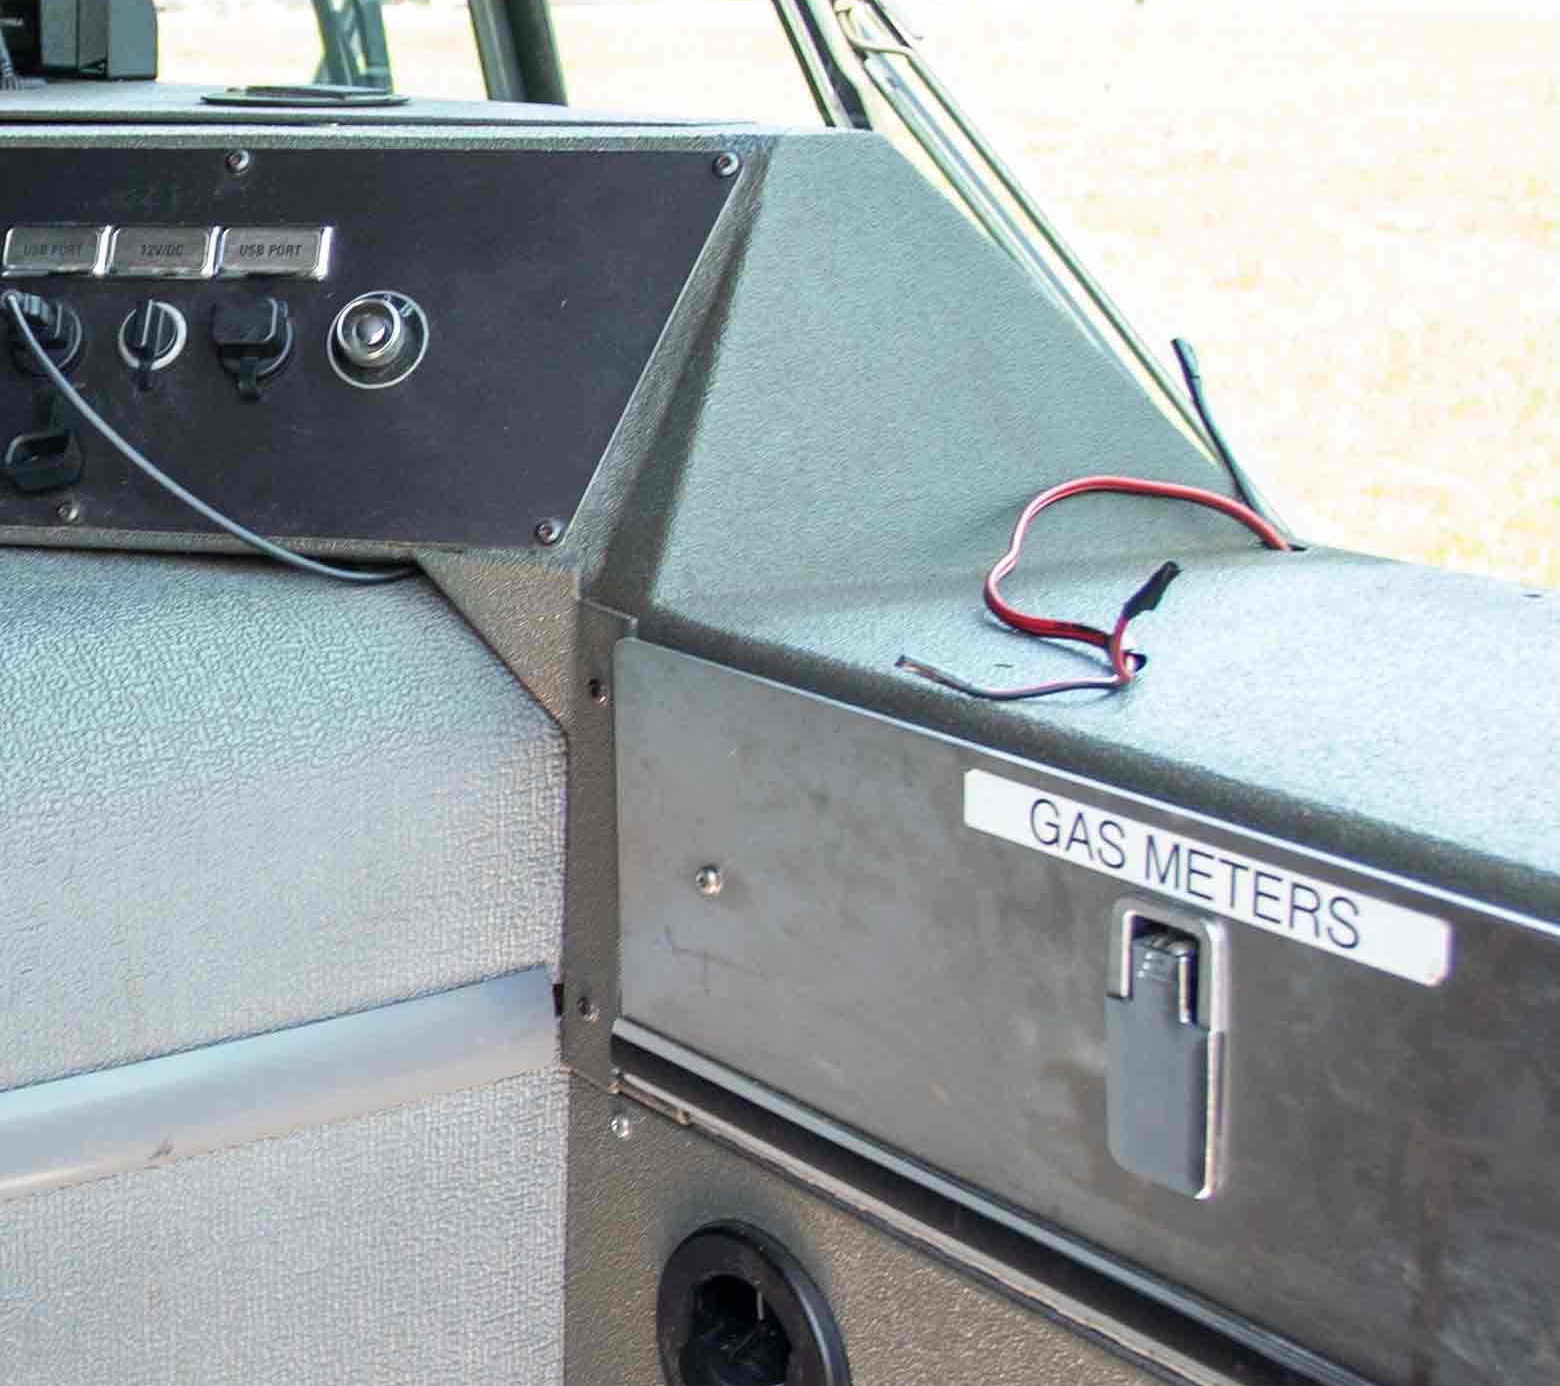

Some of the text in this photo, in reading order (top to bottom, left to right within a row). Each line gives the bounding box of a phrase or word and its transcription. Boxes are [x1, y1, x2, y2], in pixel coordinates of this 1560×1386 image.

[23, 243, 82, 256] USB PORT
[239, 243, 303, 257] USB PORT
[1029, 797, 1361, 950] GAS METERS
